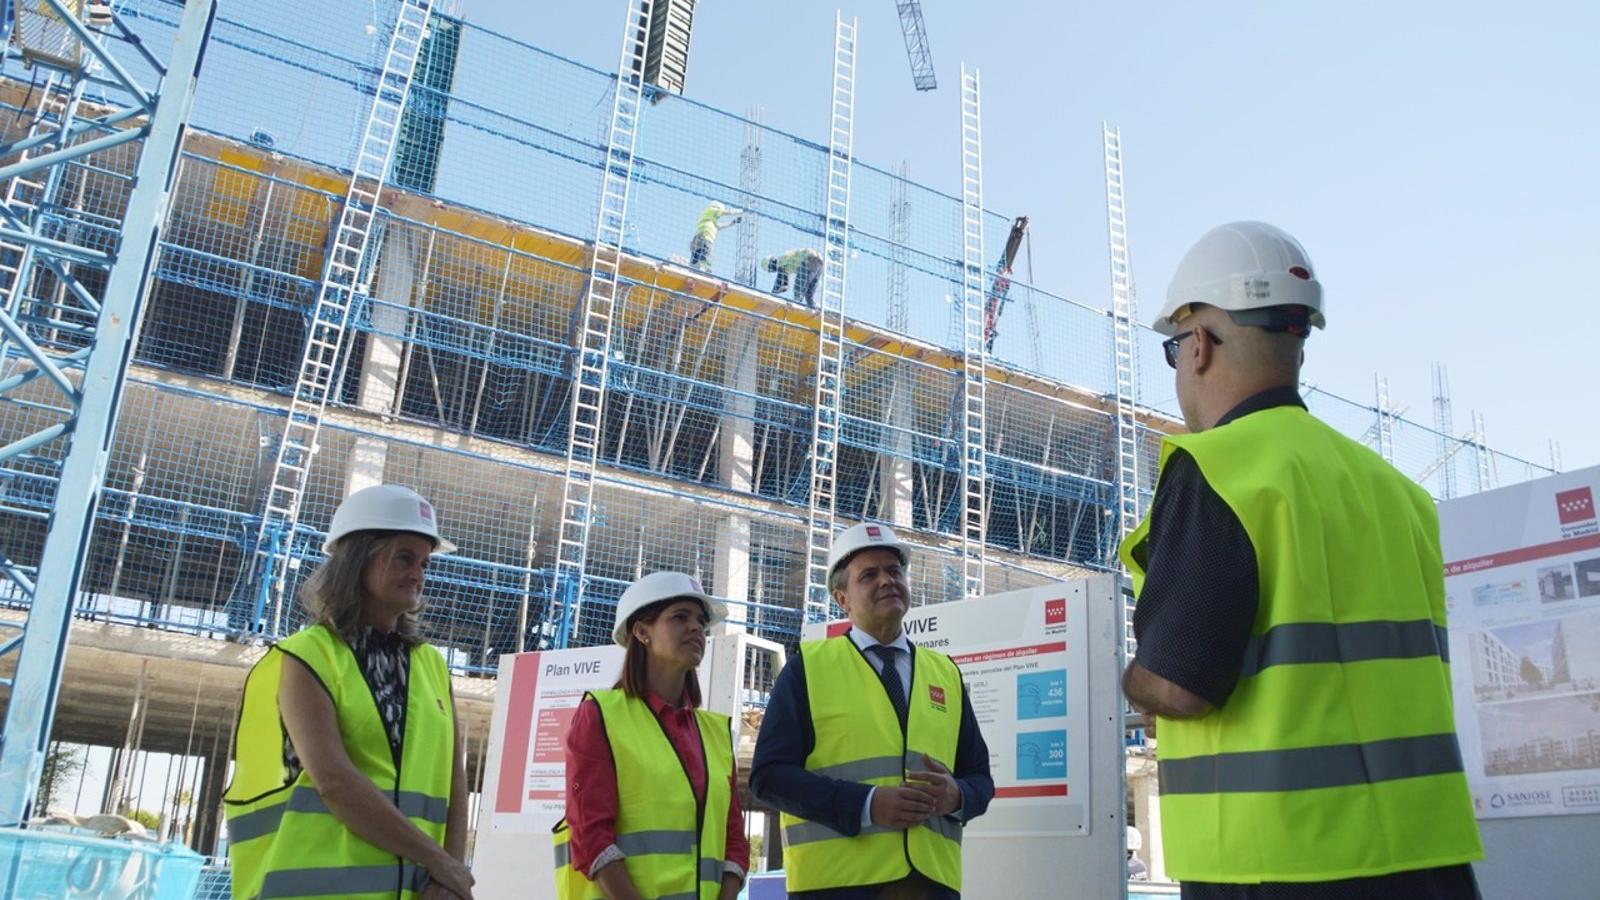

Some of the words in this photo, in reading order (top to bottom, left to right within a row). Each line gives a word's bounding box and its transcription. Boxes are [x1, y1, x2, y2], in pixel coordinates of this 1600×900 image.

[1560, 520, 1597, 533] Comunidad
[1573, 526, 1599, 536] Madrid
[1450, 564, 1461, 573] de
[1463, 558, 1494, 572] alquiler
[903, 616, 937, 635] VIVE
[953, 655, 973, 663] iendas
[545, 664, 570, 677] Plan
[574, 661, 601, 674] VIVE
[1048, 749, 1064, 759] 300
